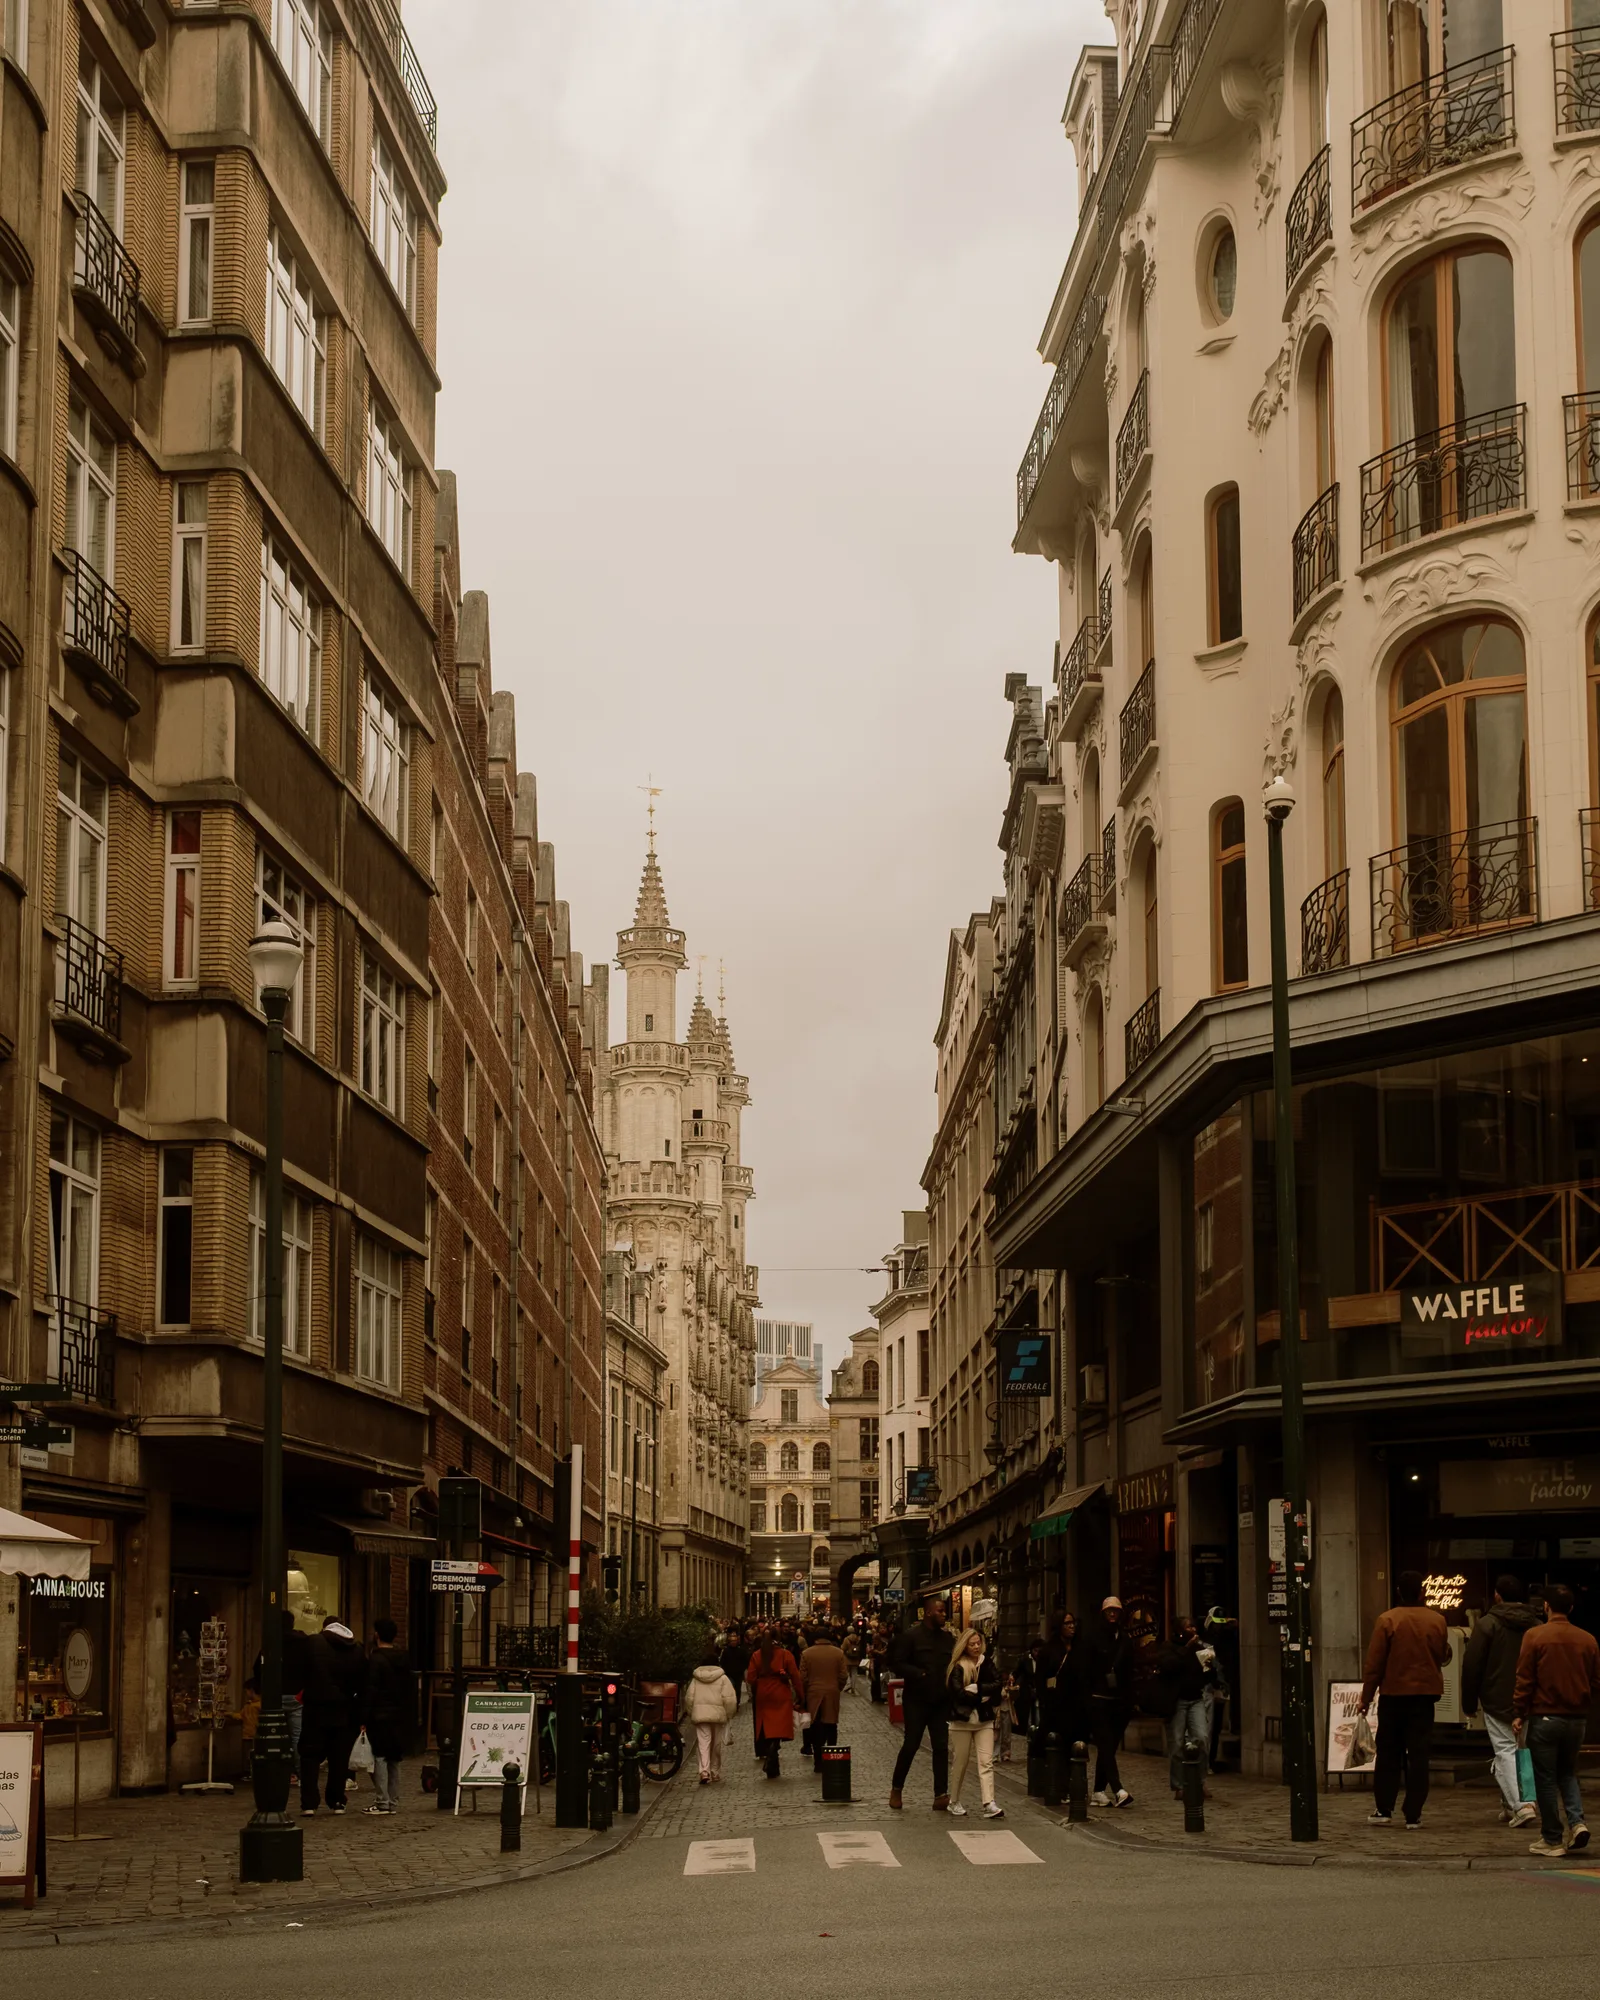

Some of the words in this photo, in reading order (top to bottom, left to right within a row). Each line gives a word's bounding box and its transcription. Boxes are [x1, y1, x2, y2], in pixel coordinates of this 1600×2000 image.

[1411, 1284, 1525, 1322] WAFFLE
[1464, 1314, 1548, 1345] factory
[1005, 1382, 1048, 1391] FEDERALE
[1117, 1474, 1158, 1513] ARTISAN
[1530, 1481, 1592, 1503] factory
[432, 1575, 476, 1583] CEREMONIE
[1421, 1574, 1467, 1587] Authentic
[71, 1581, 105, 1598] HOUSE
[432, 1583, 447, 1591] DES
[448, 1582, 486, 1592] DIPLÔMES
[1425, 1586, 1463, 1597] belgian
[1426, 1595, 1463, 1609] waffles
[68, 1655, 89, 1670] Mary
[0, 1783, 15, 1791] as
